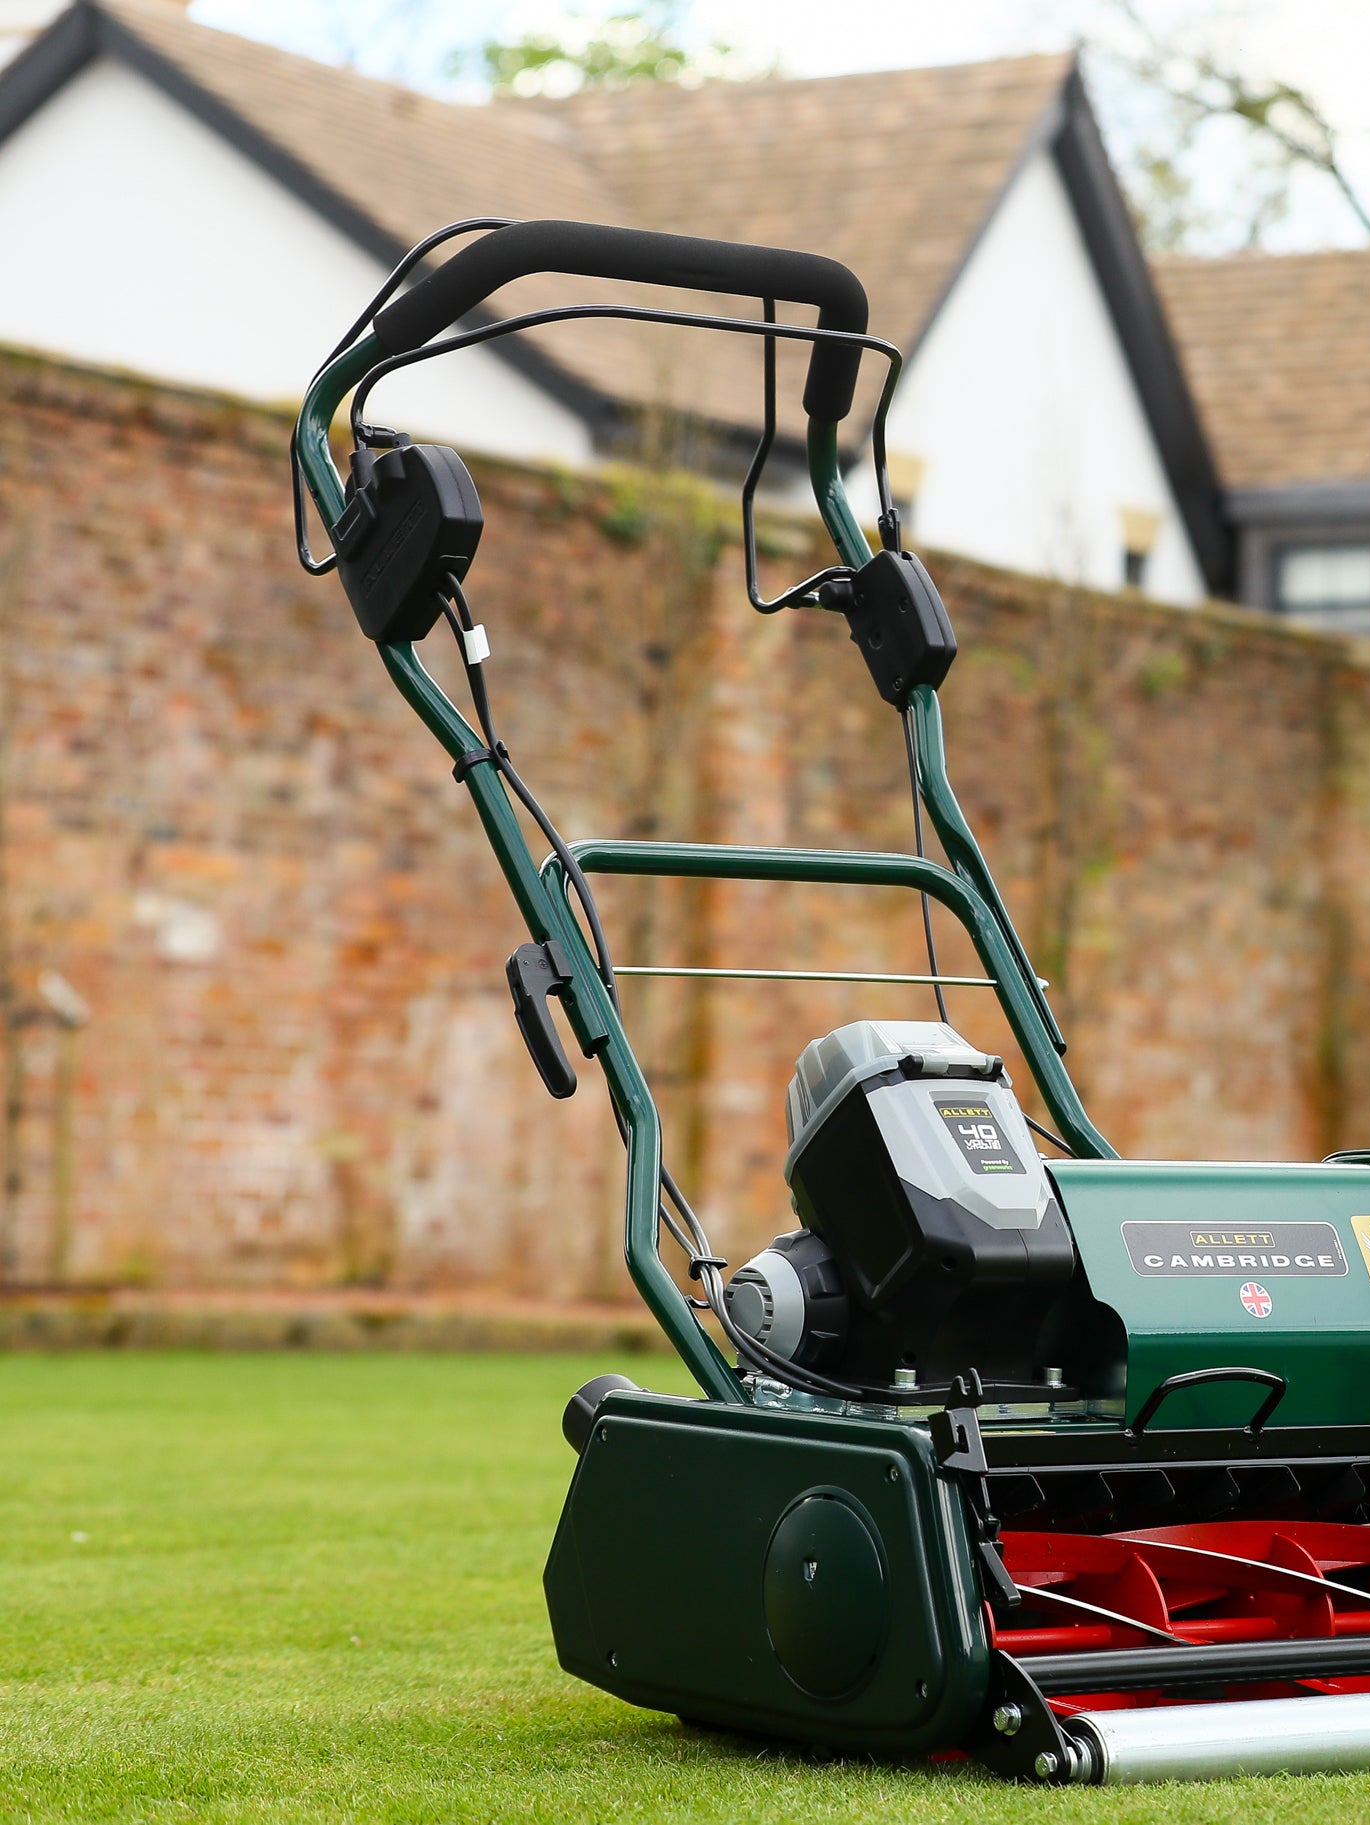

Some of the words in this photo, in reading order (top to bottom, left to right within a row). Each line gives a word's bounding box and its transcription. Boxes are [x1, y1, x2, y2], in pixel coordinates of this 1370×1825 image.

[957, 1124, 998, 1140] 40
[1195, 1234, 1270, 1244] ALLETT
[1143, 1254, 1336, 1268] CAMBRIDGE
